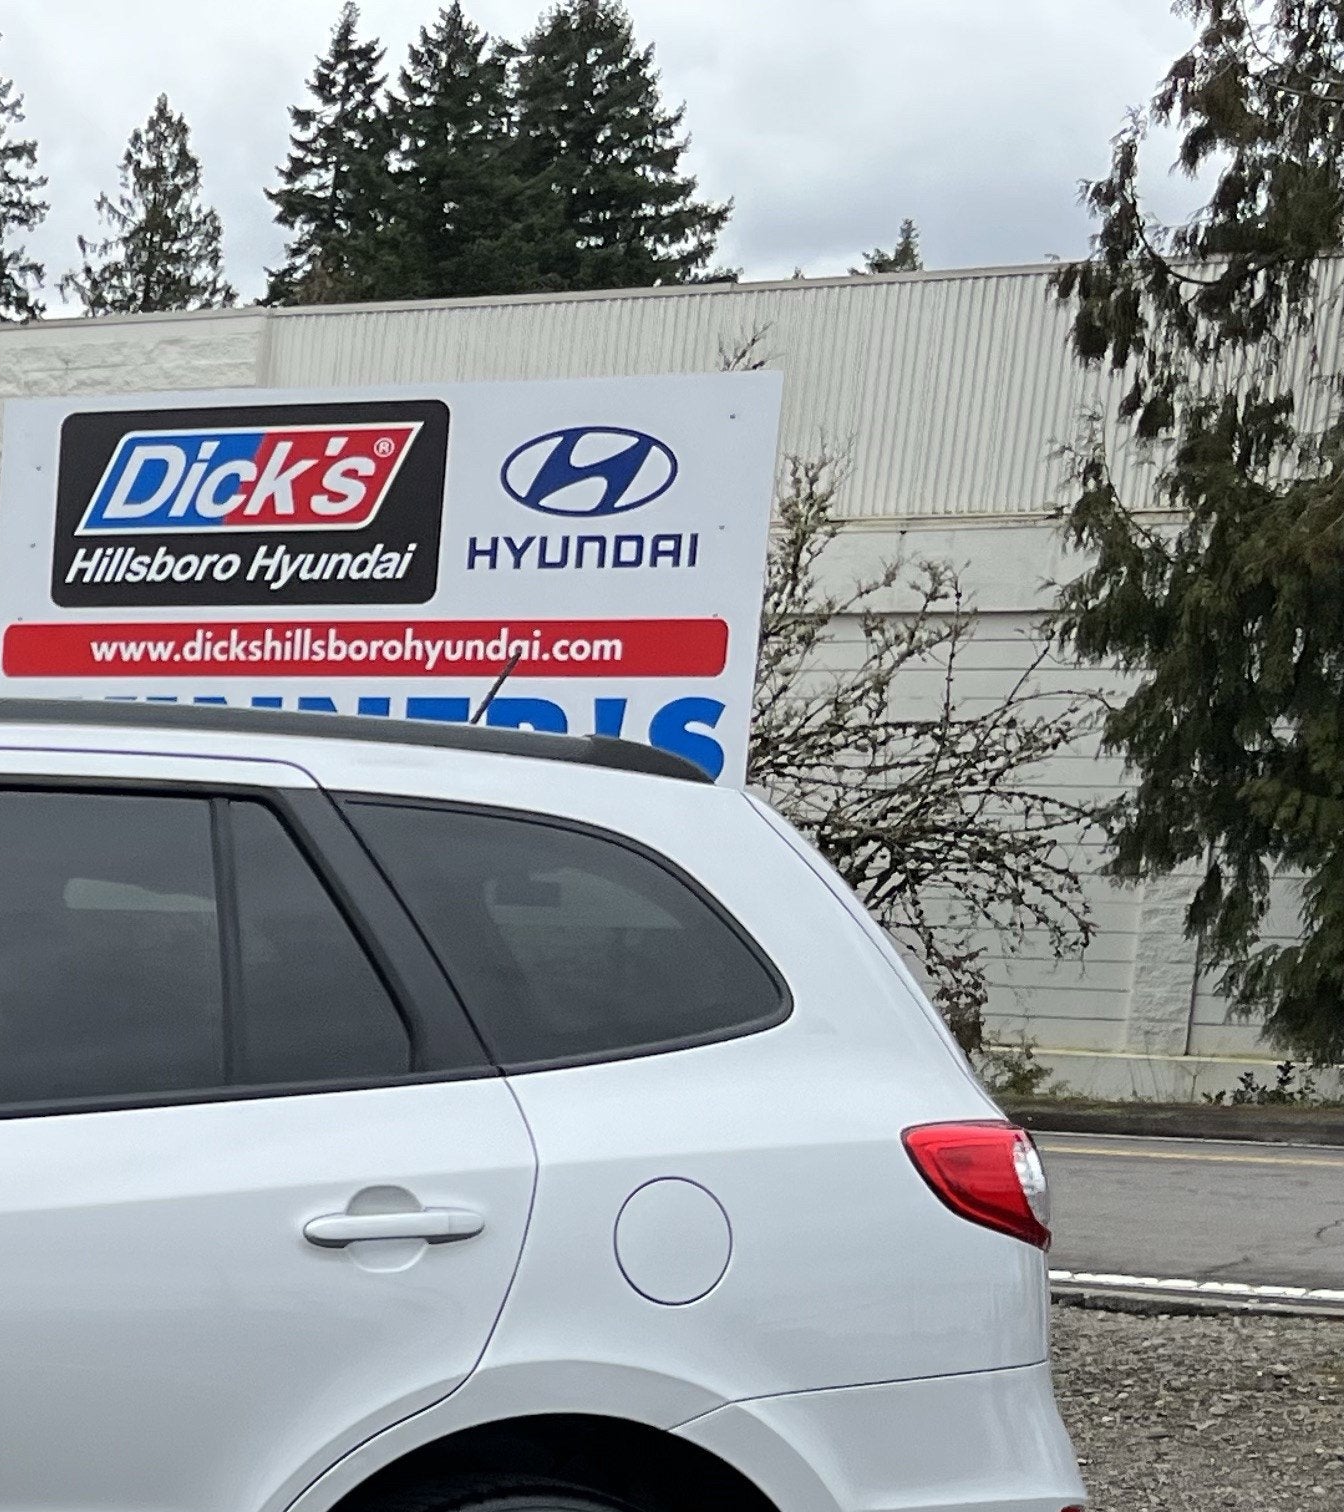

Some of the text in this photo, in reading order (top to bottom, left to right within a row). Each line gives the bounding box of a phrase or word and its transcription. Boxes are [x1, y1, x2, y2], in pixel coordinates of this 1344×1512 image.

[64, 543, 417, 590] Hillsboro Hyundai
[467, 533, 699, 570] HYUNDAI
[90, 628, 623, 670] www.dickshillsborohyundai.com
